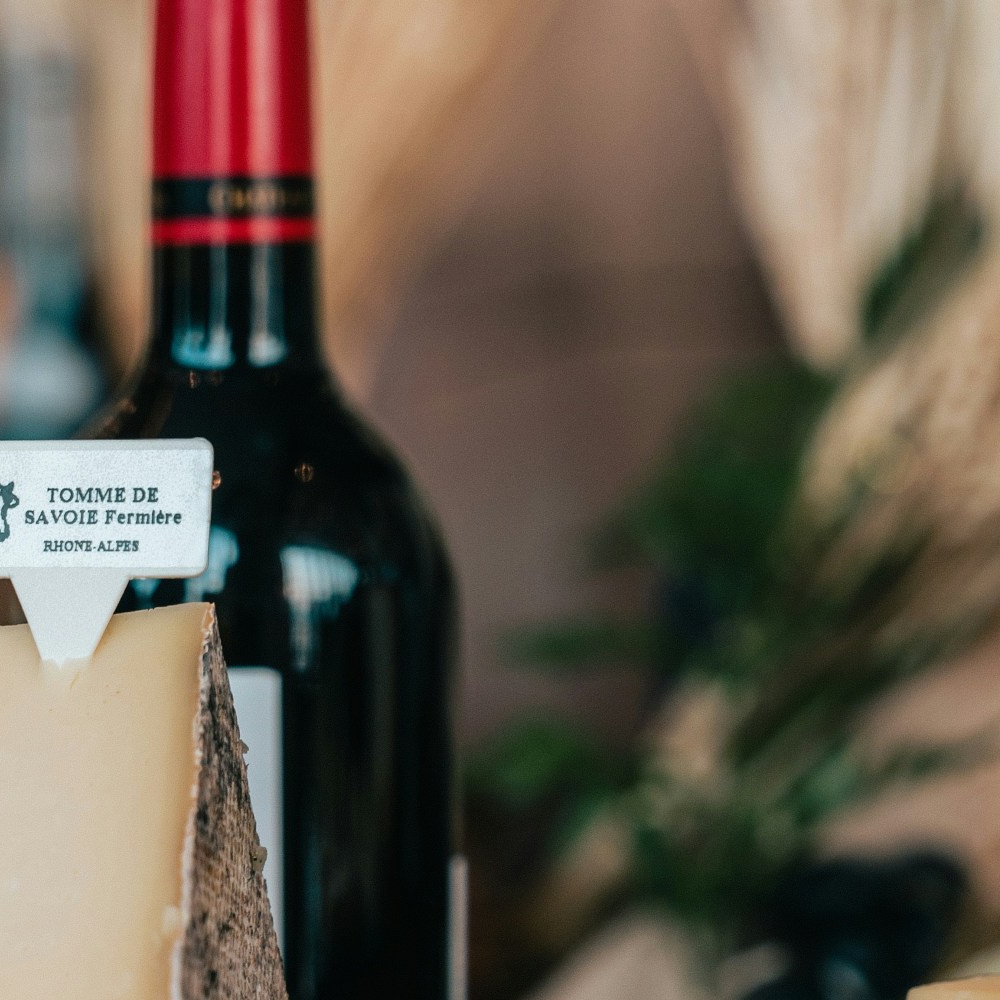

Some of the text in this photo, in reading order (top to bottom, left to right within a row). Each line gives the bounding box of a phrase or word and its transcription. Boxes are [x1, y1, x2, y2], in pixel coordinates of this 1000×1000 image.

[47, 487, 160, 503] TOMME DE
[24, 509, 183, 525] SAVOIE Fermière
